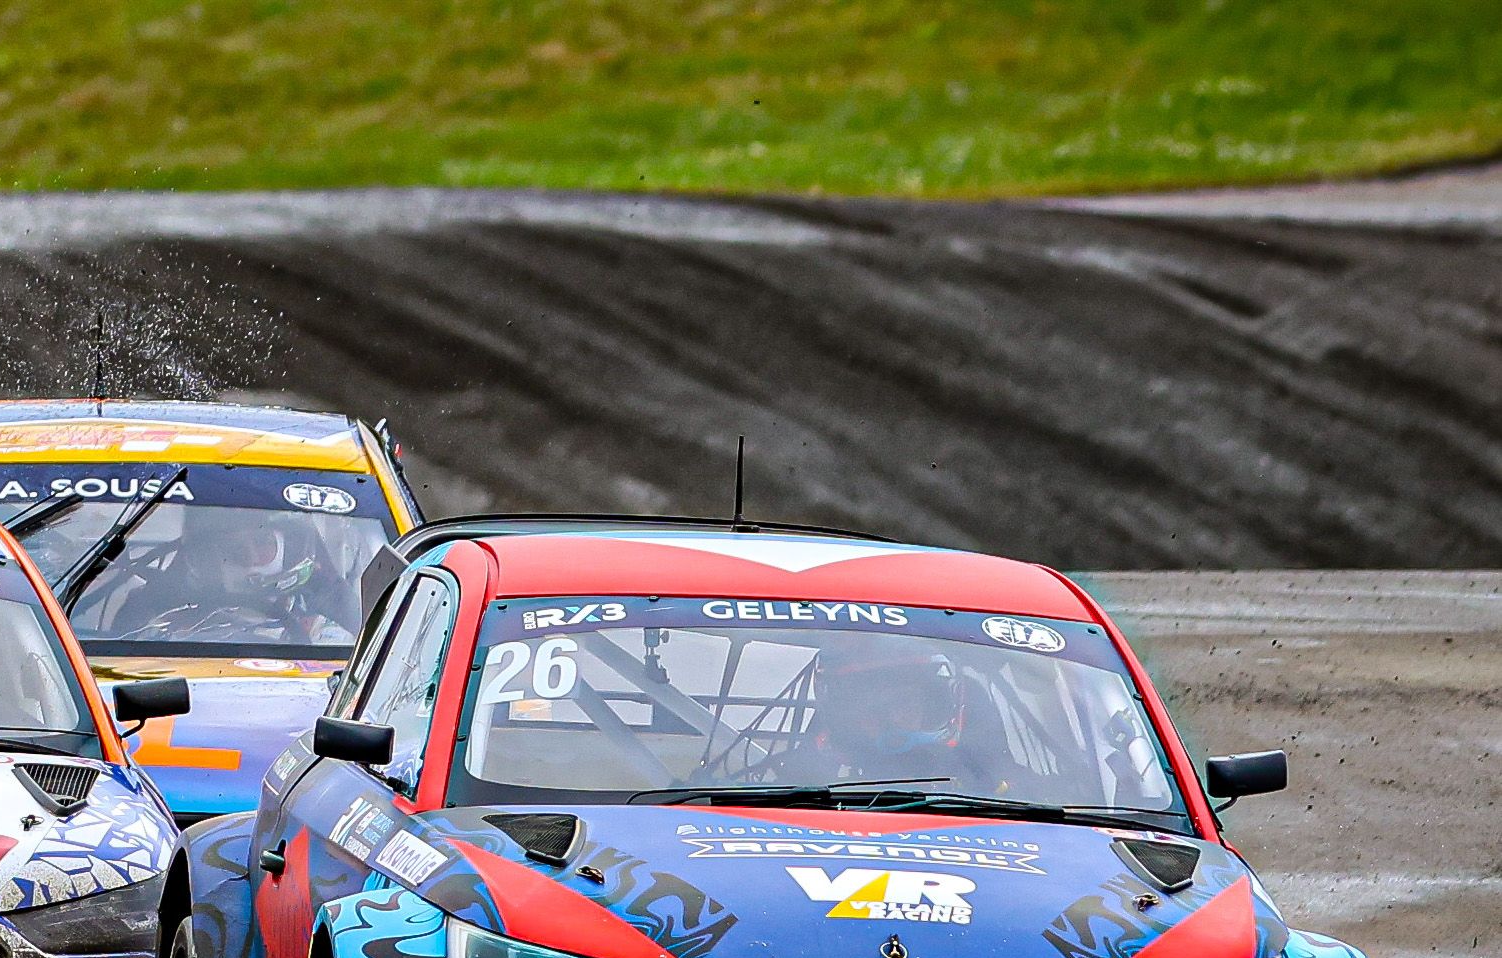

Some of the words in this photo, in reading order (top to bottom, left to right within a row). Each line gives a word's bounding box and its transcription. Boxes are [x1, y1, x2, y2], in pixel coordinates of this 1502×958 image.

[50, 478, 195, 500] SOUSA
[285, 484, 354, 511] FIA
[536, 603, 626, 628] RX3
[703, 600, 909, 626] GELEYNS
[984, 617, 1062, 651] FIA
[480, 638, 579, 705] 26
[705, 825, 883, 838] lighthouse
[898, 832, 1040, 852] yachting
[722, 842, 1010, 866] RAVENOL
[868, 908, 973, 925] RACING
